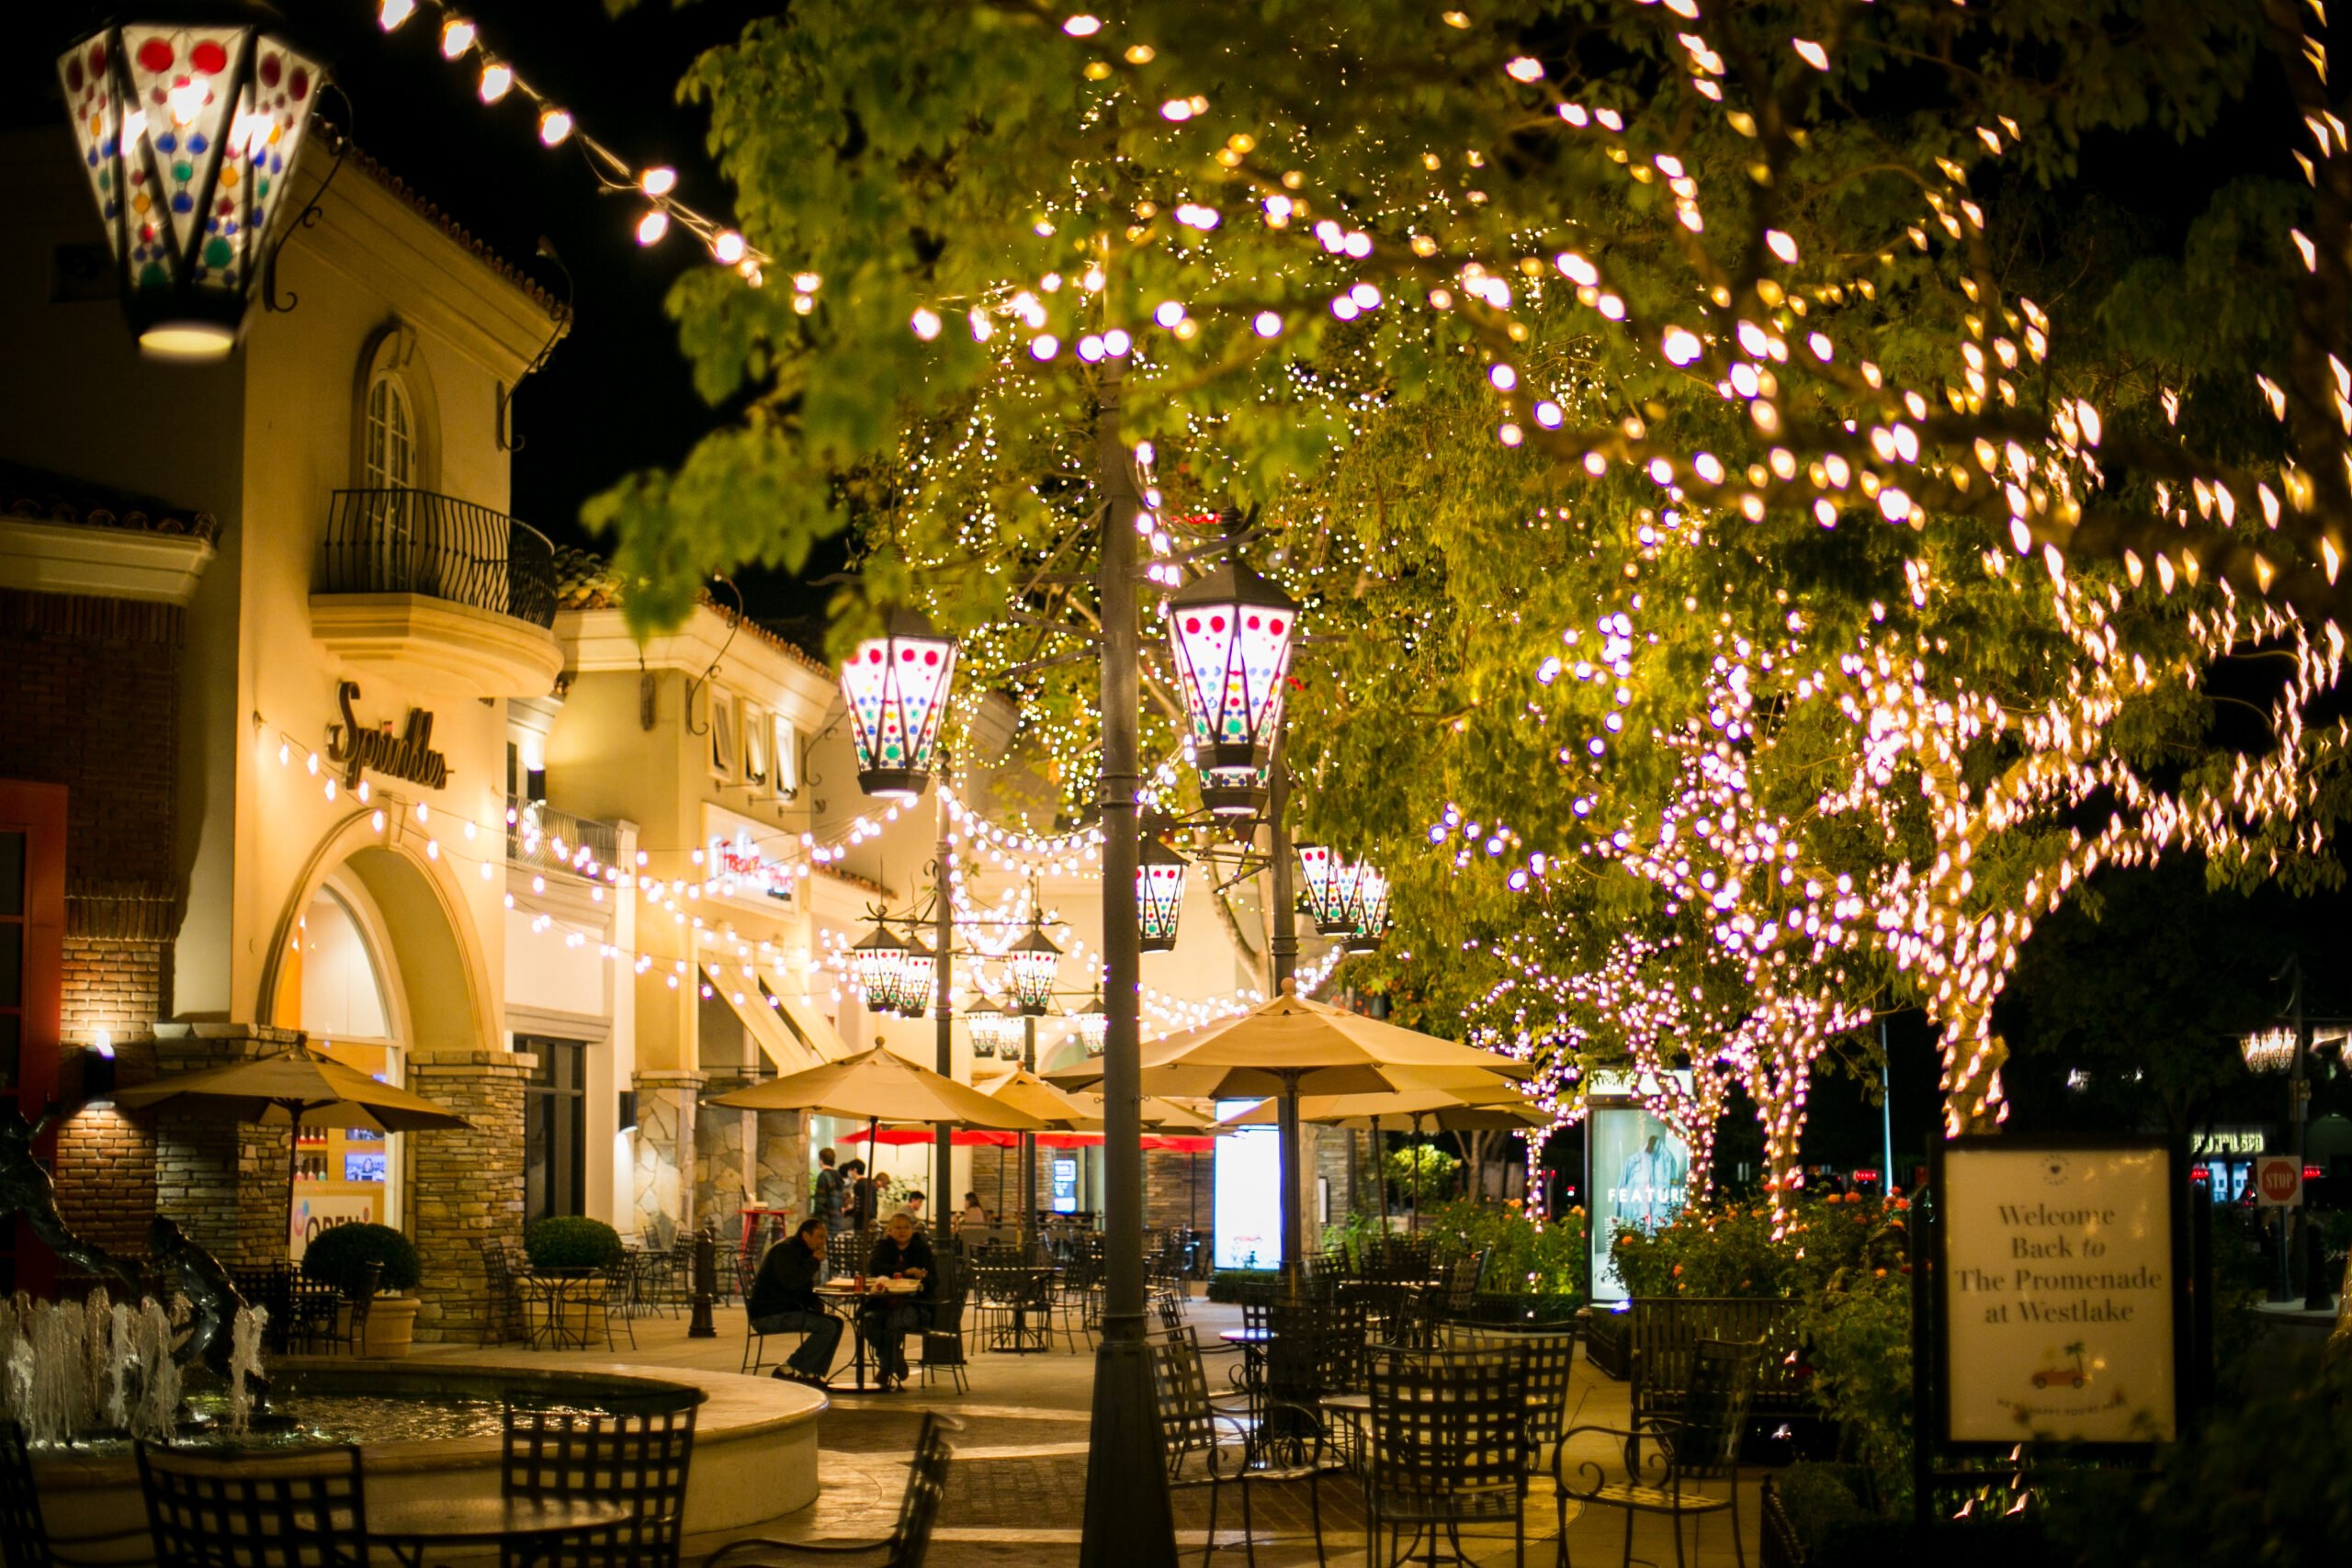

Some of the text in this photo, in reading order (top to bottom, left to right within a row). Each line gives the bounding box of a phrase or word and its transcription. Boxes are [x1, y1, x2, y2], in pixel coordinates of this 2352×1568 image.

[325, 681, 455, 790] Sprinkles
[2266, 1172, 2293, 1189] STOP
[1999, 1203, 2115, 1226] Welcome
[305, 1215, 360, 1246] OP
[2011, 1235, 2106, 1258] Back to
[1954, 1266, 2162, 1292] The Promenade
[1984, 1300, 2134, 1324] at Westlake
